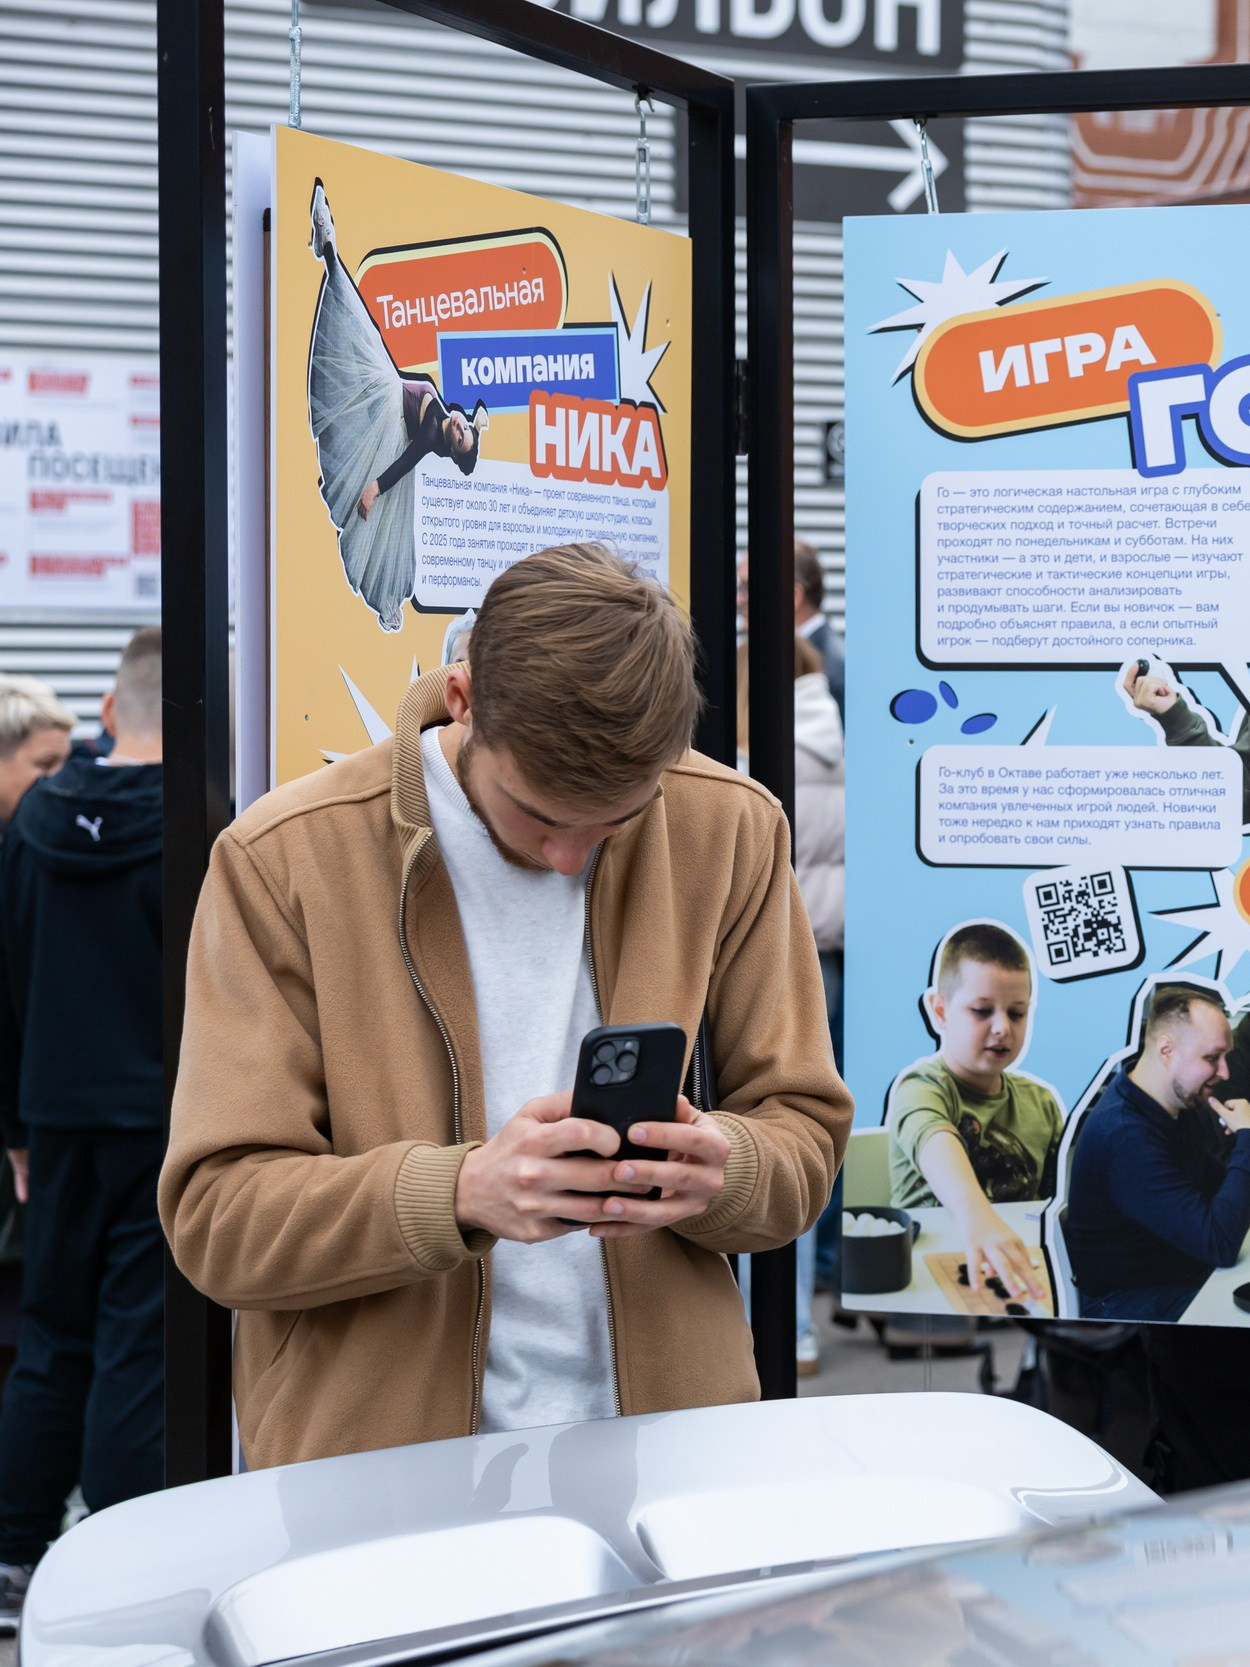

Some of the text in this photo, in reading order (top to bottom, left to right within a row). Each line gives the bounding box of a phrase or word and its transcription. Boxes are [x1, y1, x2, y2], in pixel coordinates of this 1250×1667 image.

[376, 277, 545, 330] Танцевальная
[979, 324, 1157, 393] ИГРА
[460, 352, 595, 386] компания
[0, 420, 62, 446] ИЛА
[535, 404, 662, 478] НИКА
[421, 473, 472, 490] Танцевальная
[473, 481, 507, 494] компания
[508, 482, 532, 496] «Ника»
[542, 488, 565, 500] проект
[566, 491, 611, 504] современного
[937, 483, 1241, 498] Го это логическая настольная игра с глубоким
[421, 495, 464, 511] существует
[465, 499, 487, 511] около
[488, 500, 497, 512] 30
[498, 503, 510, 513] лет
[511, 504, 516, 513] и
[517, 503, 556, 517] объединяет
[557, 508, 584, 522] детскую
[631, 515, 653, 526] классы
[936, 499, 1250, 516] стратегическим содержанием, сочетающая в себе
[421, 515, 460, 529] открытого
[461, 519, 486, 531] уровня
[487, 521, 501, 532] для
[502, 522, 535, 534] взрослых
[536, 525, 541, 534] и
[542, 525, 583, 540] молодежную
[936, 517, 1217, 533] творческих подход и точный расчет. Встречи
[421, 533, 428, 545] С
[429, 533, 448, 546] 2025
[449, 537, 465, 549] года
[467, 538, 495, 549] занятия
[496, 540, 528, 553] проходят
[530, 543, 535, 553] в
[937, 534, 1233, 549] проходят по понедельникам и субботам. На них
[421, 554, 475, 570] современному
[476, 558, 497, 571] танцу
[499, 559, 504, 570] и
[936, 552, 1243, 566] участники а это и дети, и взрослые изучают
[421, 573, 482, 588] и перформансы.
[936, 569, 1230, 582] стратегические и тактические концепции игры,
[937, 584, 1182, 599] развивают способности анализировать
[937, 601, 1219, 615] и продумывать шаги. Если вы новичок вам
[937, 617, 1218, 632] подробно объяснят правила, а если опытный
[937, 634, 1196, 648] игрок подберут достойного соперника.
[938, 766, 1224, 781] Го-клуб в Октаве работает уже несколько лет.
[938, 782, 1226, 797] За это время у нас сформировалась отличная
[938, 801, 1216, 814] компания увлеченных игрой людей. Новички
[938, 817, 1221, 831] тоже нередко к нам приходят узнать правила
[938, 832, 1091, 846] и опробовать свои силы.
